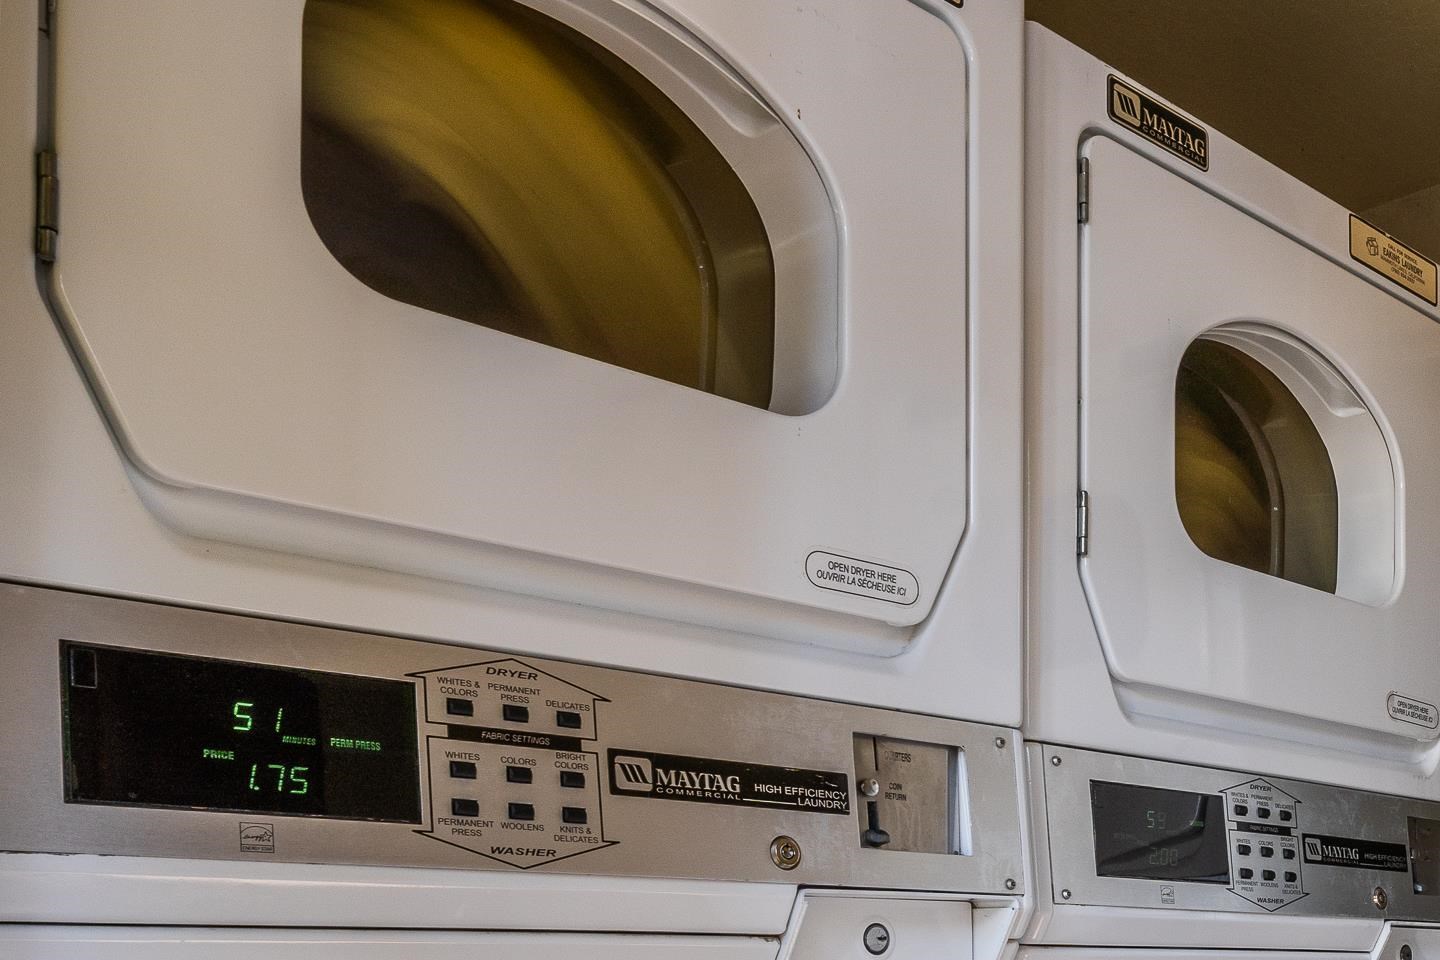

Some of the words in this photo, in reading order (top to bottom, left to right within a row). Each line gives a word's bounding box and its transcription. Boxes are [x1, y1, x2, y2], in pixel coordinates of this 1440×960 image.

[1143, 107, 1205, 157] MAYTAG
[1142, 125, 1204, 165] COMMERCIAL
[828, 561, 849, 574] OPEN
[850, 565, 876, 579] DRYER
[877, 571, 897, 583] HERE
[816, 569, 846, 583] OUVRIR
[847, 576, 856, 586] LA
[896, 586, 906, 596] ICI
[486, 667, 539, 681] DRYER
[437, 676, 472, 688] WHITES
[473, 680, 481, 689] &
[440, 686, 478, 698] COLORS
[487, 683, 541, 696] PERMANENT
[500, 693, 530, 704] PRESS
[545, 700, 590, 711] DELICATES
[282, 735, 316, 746] MINUTES
[330, 737, 353, 748] PERM
[355, 740, 381, 750] PRESS
[481, 731, 510, 742] FABRIC
[512, 733, 550, 746] SETTINGS
[203, 749, 235, 760] PRICE
[445, 751, 480, 761] WHITES
[555, 752, 586, 761] BRIGHT
[500, 756, 537, 766] COLORS
[554, 761, 589, 771] COLORS
[250, 764, 308, 794] 1.75
[655, 768, 741, 793] MAYTAG
[754, 783, 782, 795] HIGH
[784, 786, 847, 799] EFFICIENCY
[889, 782, 903, 791] COIN
[1250, 783, 1272, 792] DRYER
[656, 787, 741, 800] COMMERCIAL
[884, 792, 907, 801] RETURN
[797, 797, 848, 809] LAUNDRY
[437, 817, 494, 828] PERMANENT
[500, 822, 544, 832] WOOLENS
[451, 828, 483, 837] PRESS
[559, 826, 584, 835] KNITS
[585, 827, 592, 835] &
[553, 834, 599, 844] DELICATES
[490, 846, 557, 857] WASHER
[1322, 845, 1359, 860] MAYTAG
